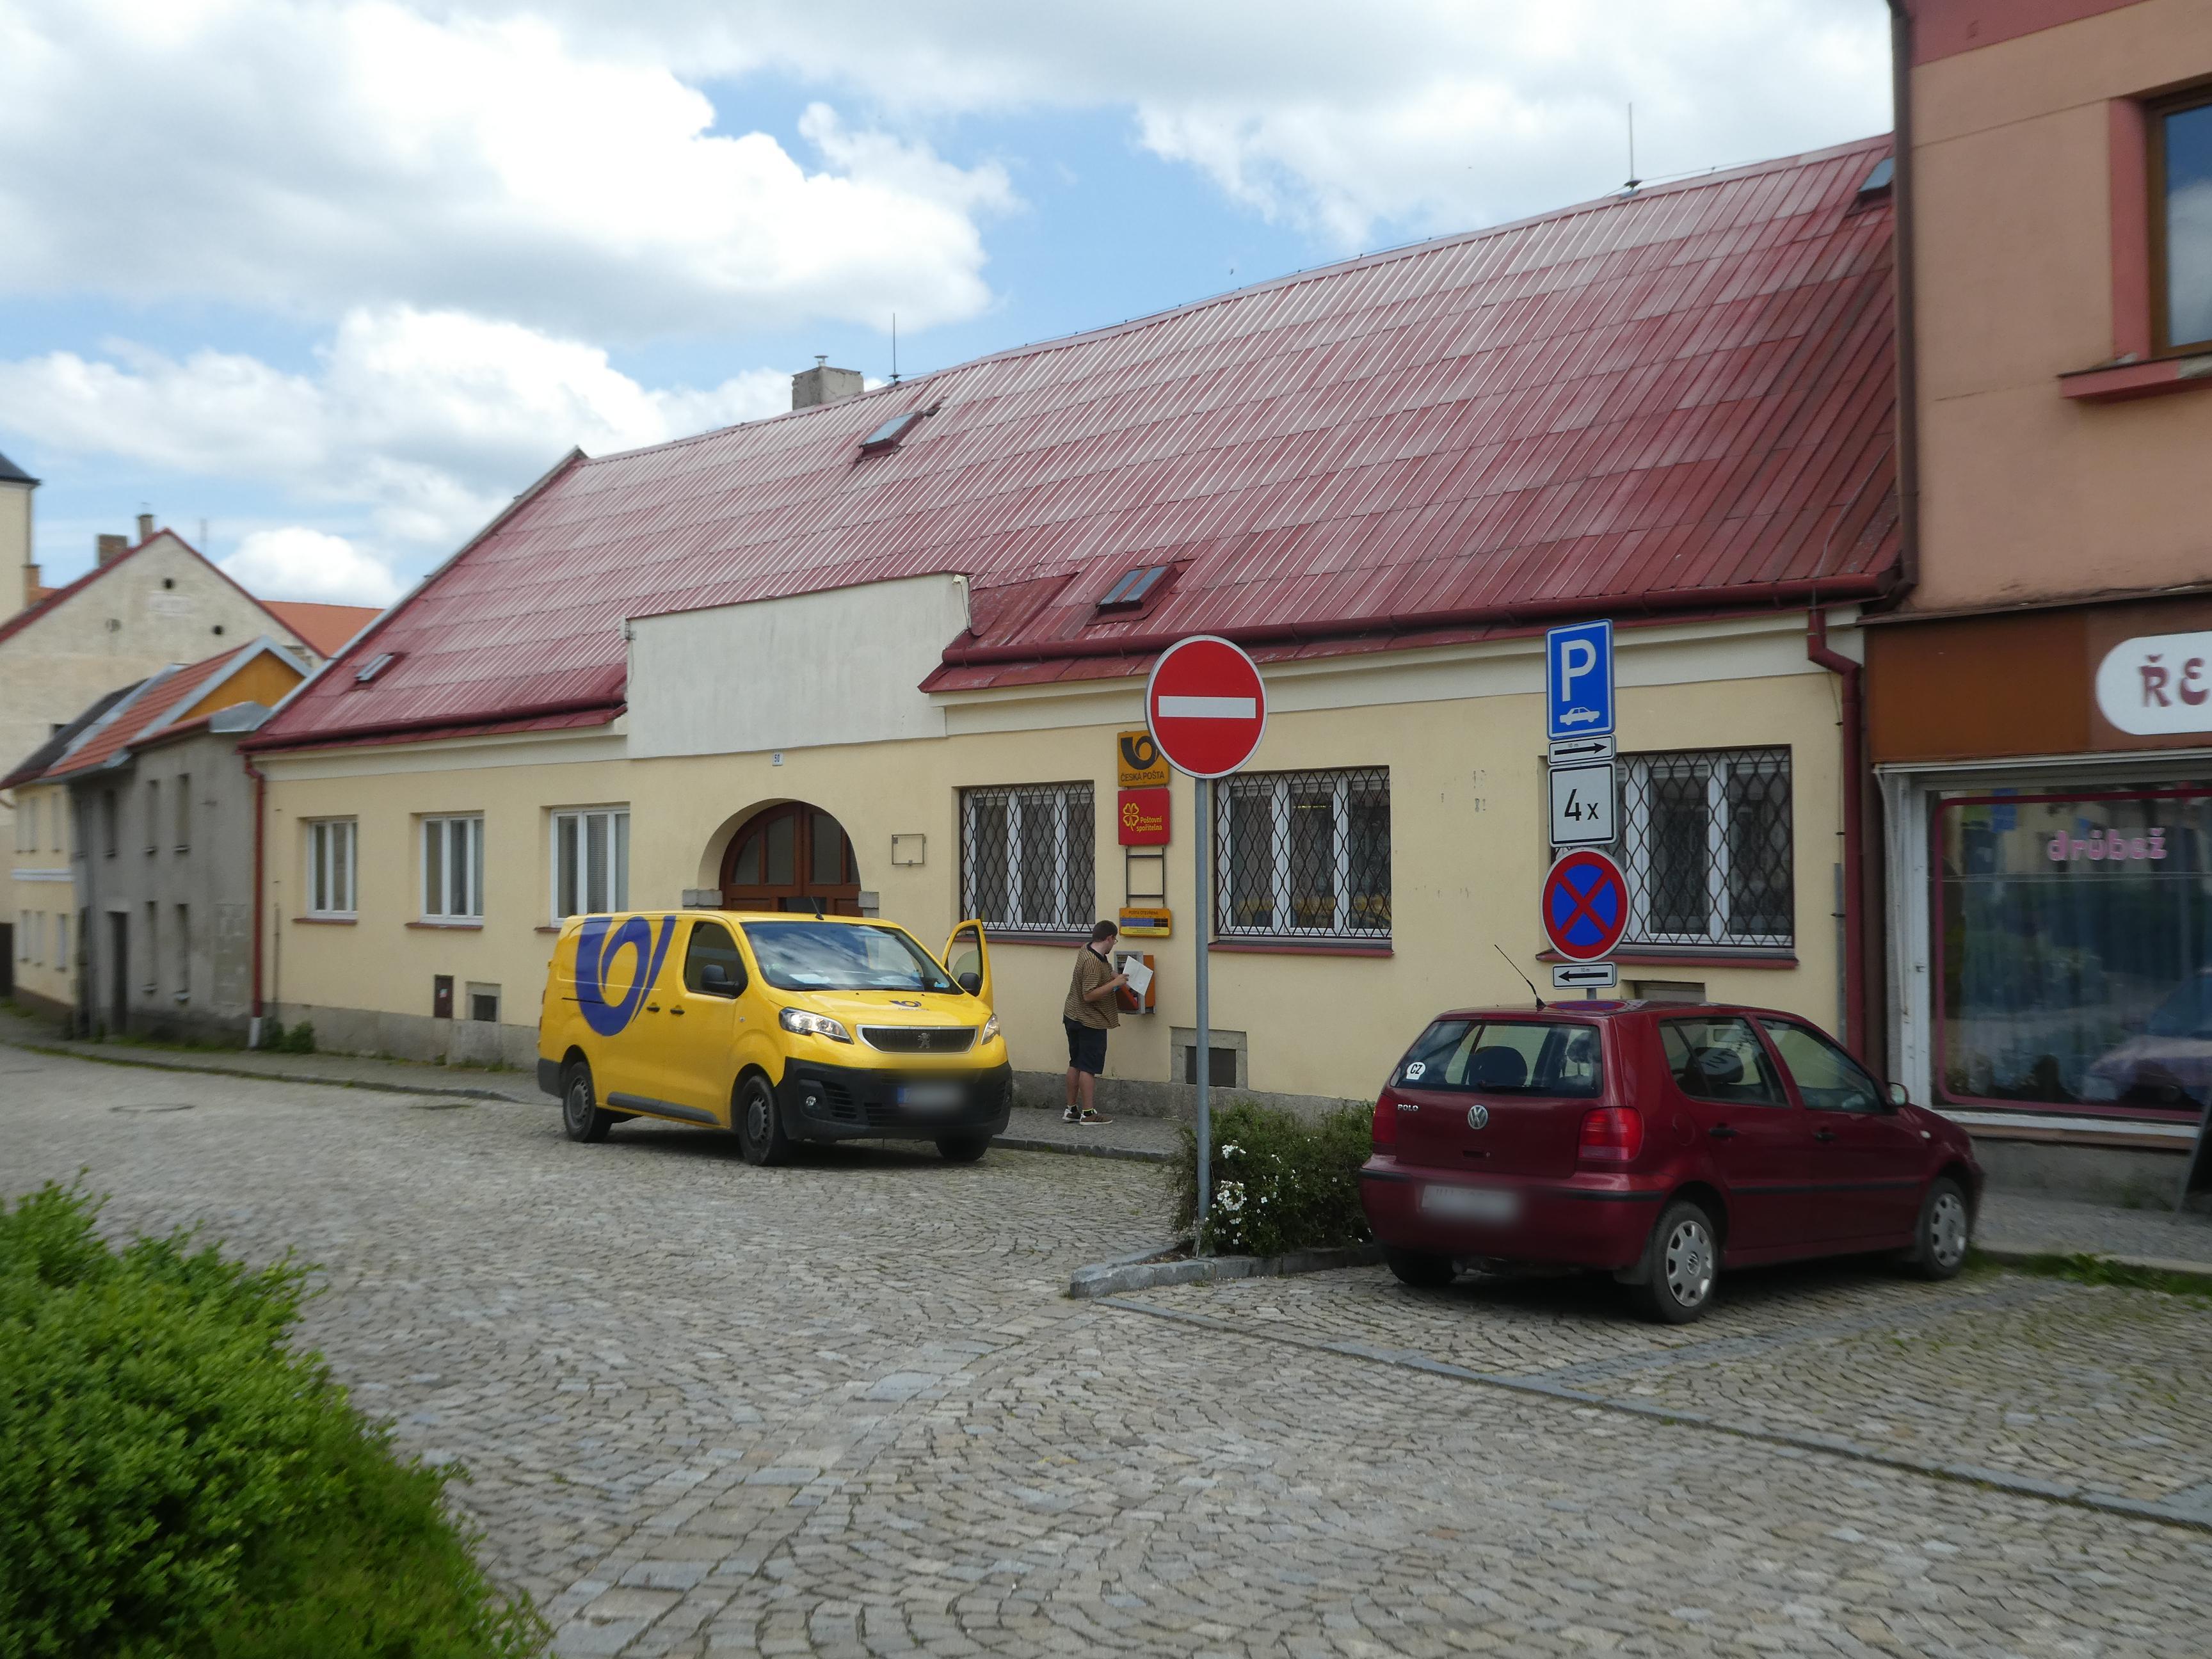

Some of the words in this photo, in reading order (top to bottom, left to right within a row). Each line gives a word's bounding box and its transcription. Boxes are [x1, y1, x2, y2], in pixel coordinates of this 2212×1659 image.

[1561, 639, 1596, 702] P
[1121, 772, 1142, 782] ČESKÁ
[1142, 770, 1164, 780] POŠTA
[1140, 815, 1162, 824] Poštovní
[1136, 824, 1163, 833] spořitelna
[1410, 1063, 1423, 1075] CZ
[1397, 1103, 1419, 1112] POLO
